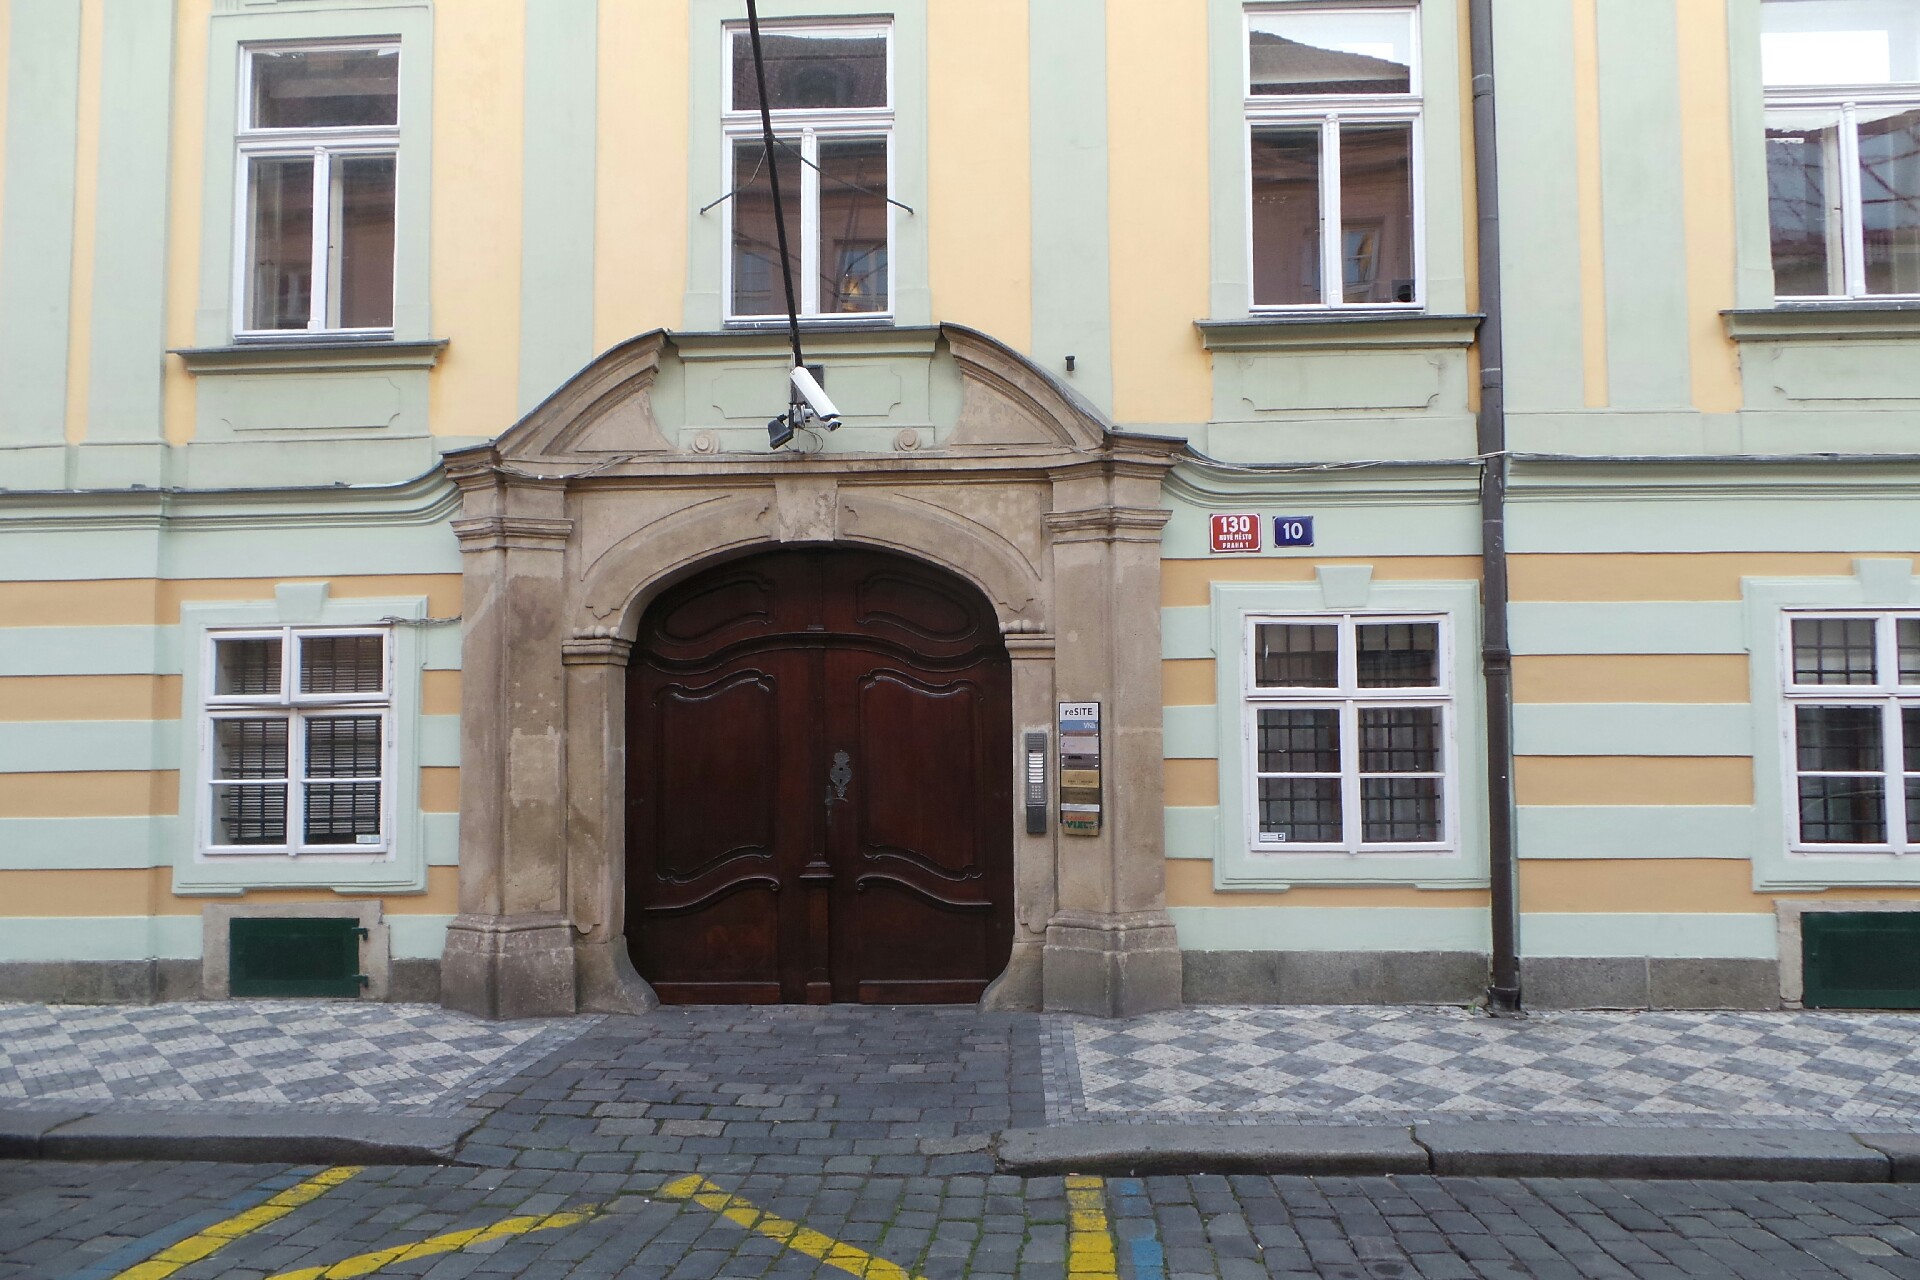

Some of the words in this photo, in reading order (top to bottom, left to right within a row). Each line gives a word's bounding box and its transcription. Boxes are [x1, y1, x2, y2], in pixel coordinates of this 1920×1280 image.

[1221, 516, 1250, 533] 130
[1283, 522, 1304, 540] 10
[1065, 707, 1093, 716] reSITE
